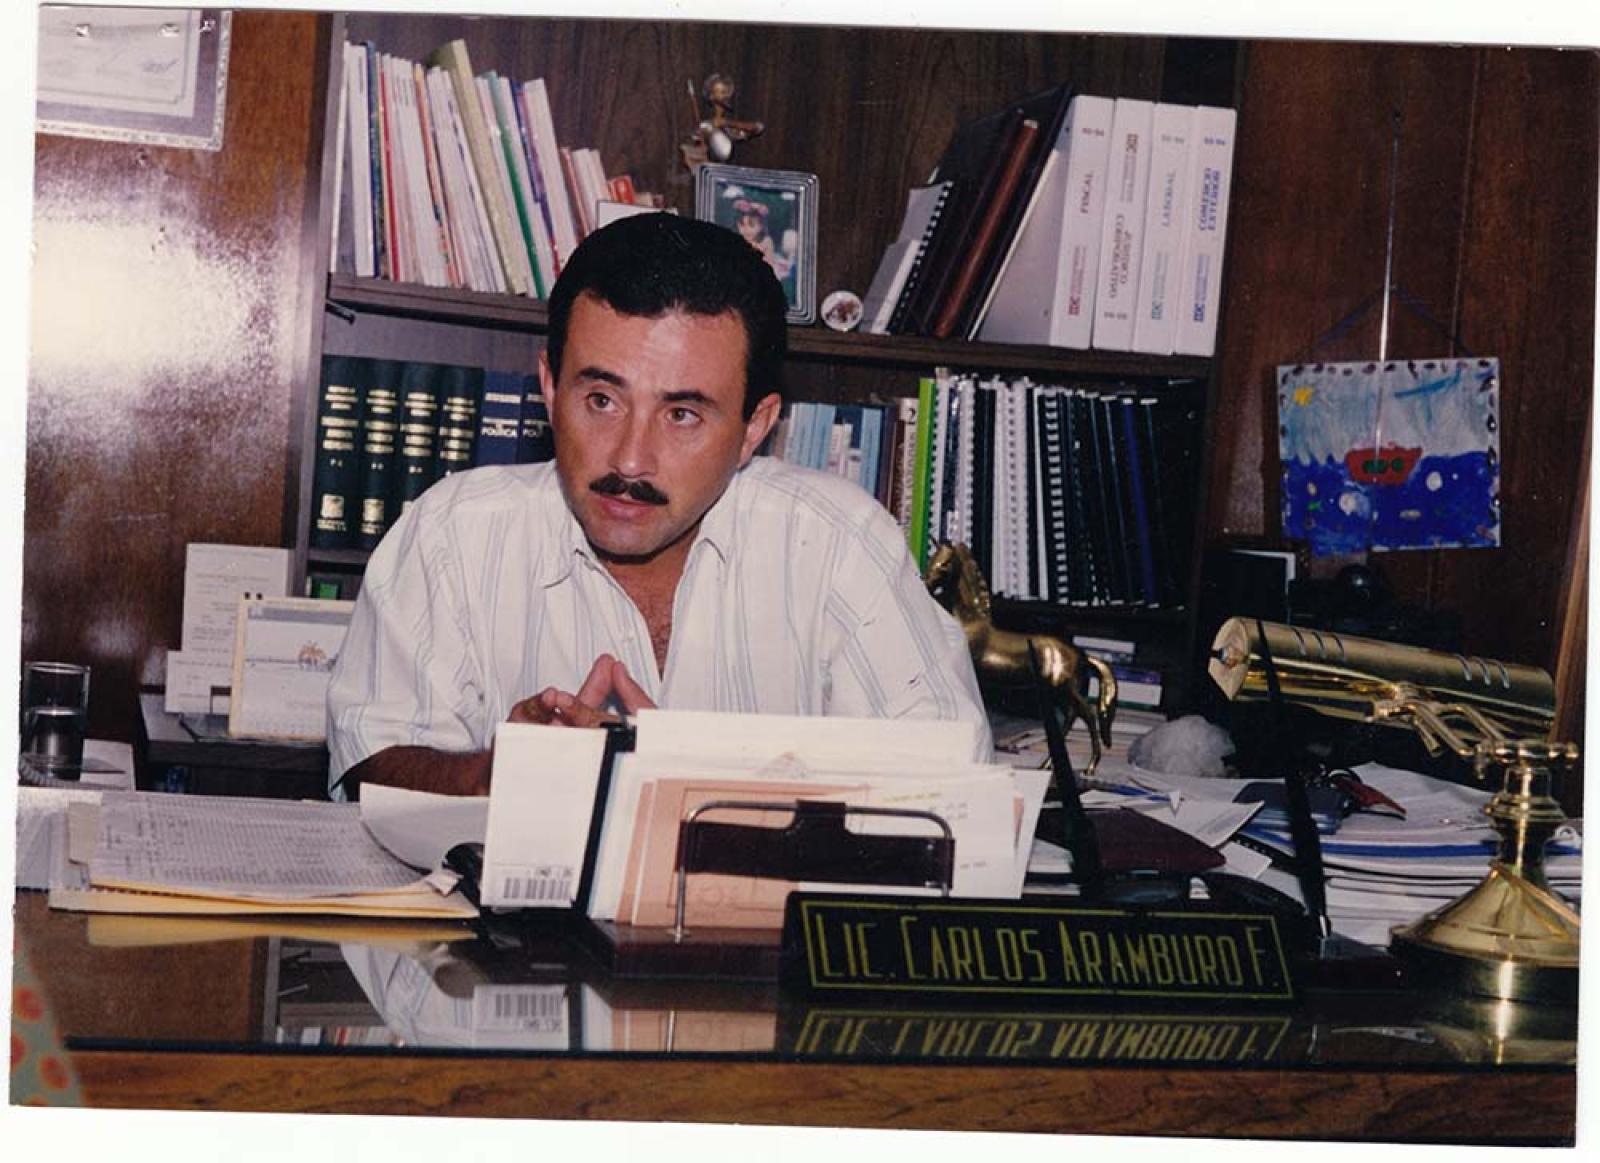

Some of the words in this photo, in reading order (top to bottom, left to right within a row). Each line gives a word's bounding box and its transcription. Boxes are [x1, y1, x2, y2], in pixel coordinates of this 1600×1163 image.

[1080, 173, 1094, 214] FISCAL
[1162, 171, 1176, 227] LABORAL
[814, 913, 896, 979] LIC.
[901, 916, 1046, 982] CARLOS
[1058, 920, 1244, 987] ARAMBURO
[1246, 926, 1279, 988] F.
